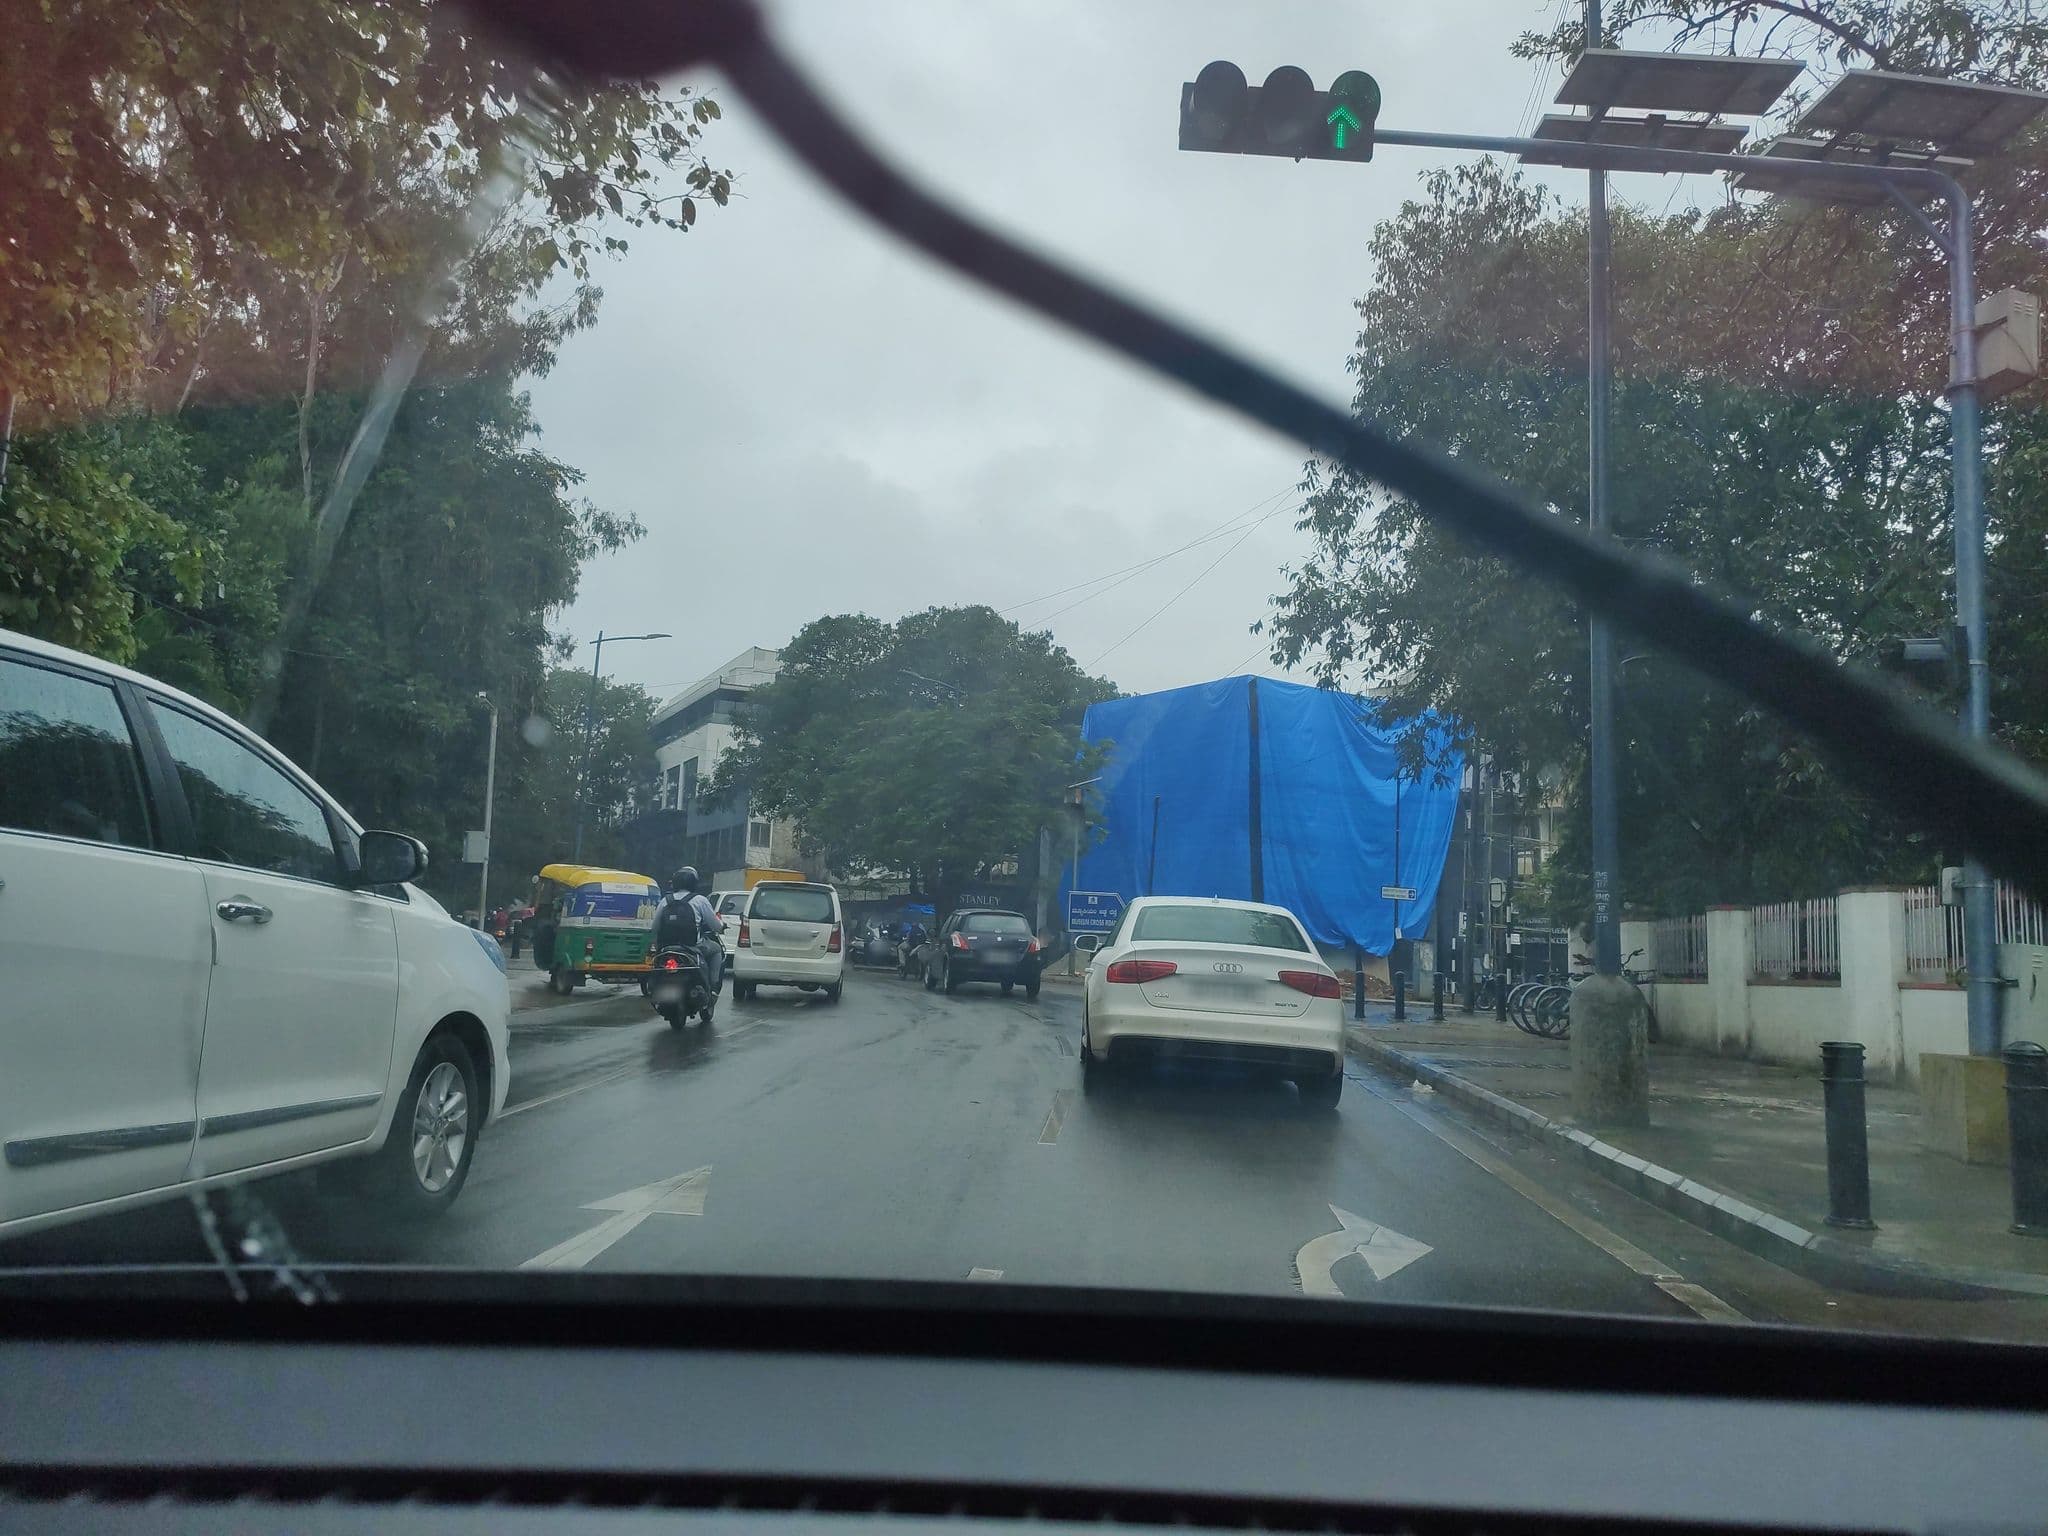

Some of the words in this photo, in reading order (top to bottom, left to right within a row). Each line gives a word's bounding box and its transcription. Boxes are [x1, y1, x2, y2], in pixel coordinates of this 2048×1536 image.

[960, 894, 1001, 906] STANLEY
[586, 902, 596, 915] 7
[1090, 918, 1105, 926] CROSS
